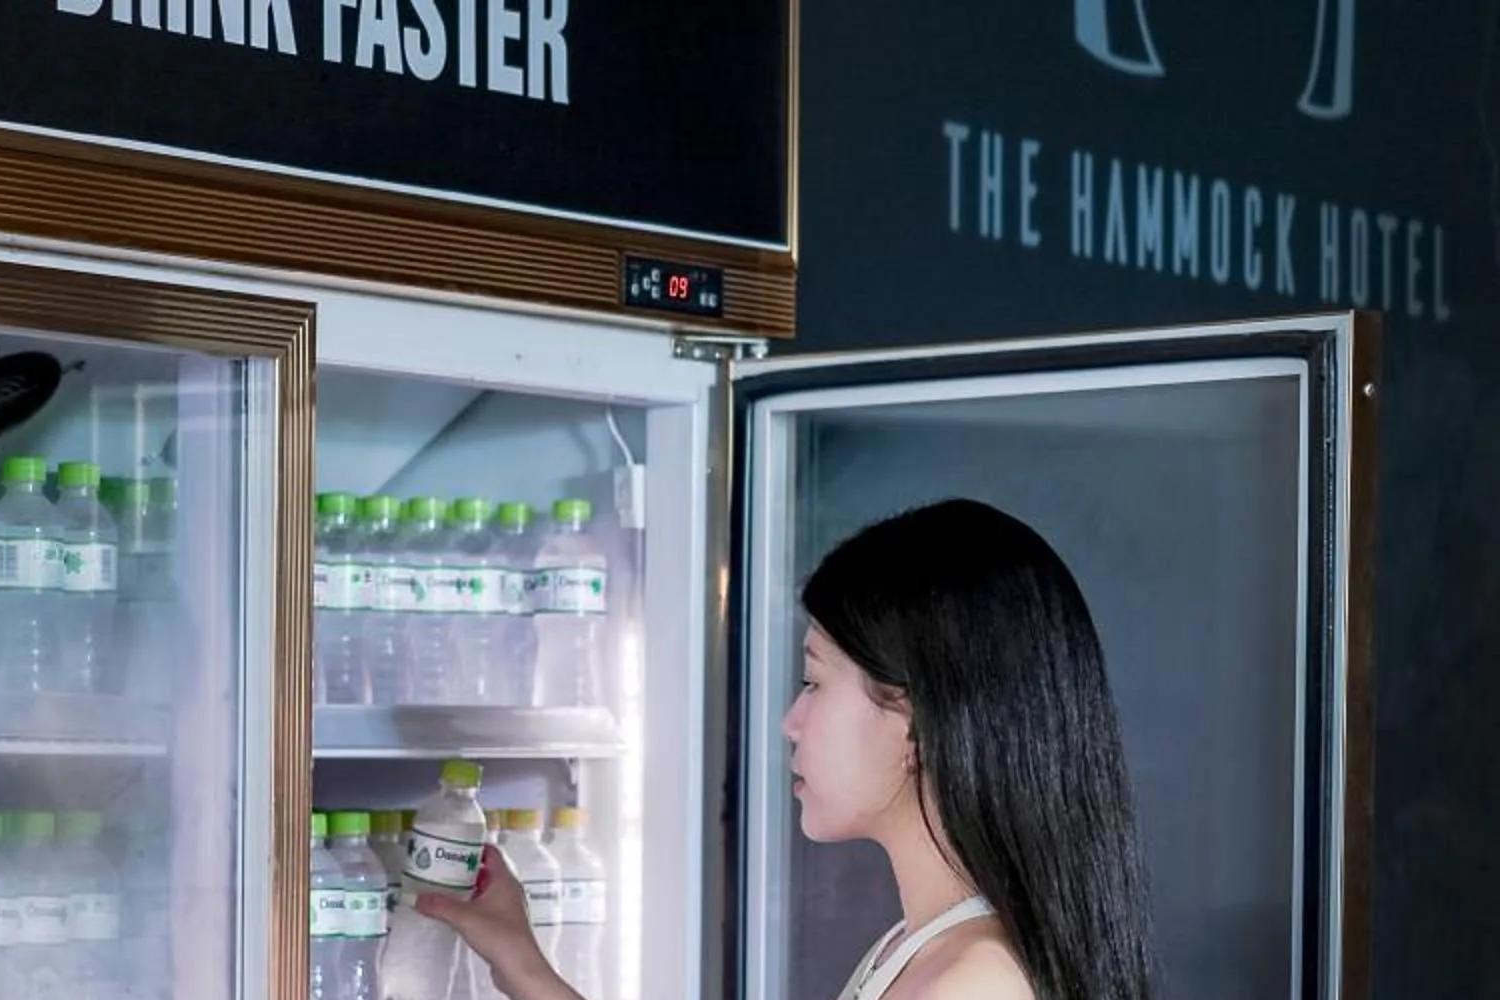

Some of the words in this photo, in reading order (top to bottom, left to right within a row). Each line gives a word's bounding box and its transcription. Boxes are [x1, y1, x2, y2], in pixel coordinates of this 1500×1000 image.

[943, 121, 1042, 247] THE
[1071, 151, 1295, 296] HAMMOCK
[1319, 202, 1449, 322] HOTEL
[669, 276, 688, 298] 09
